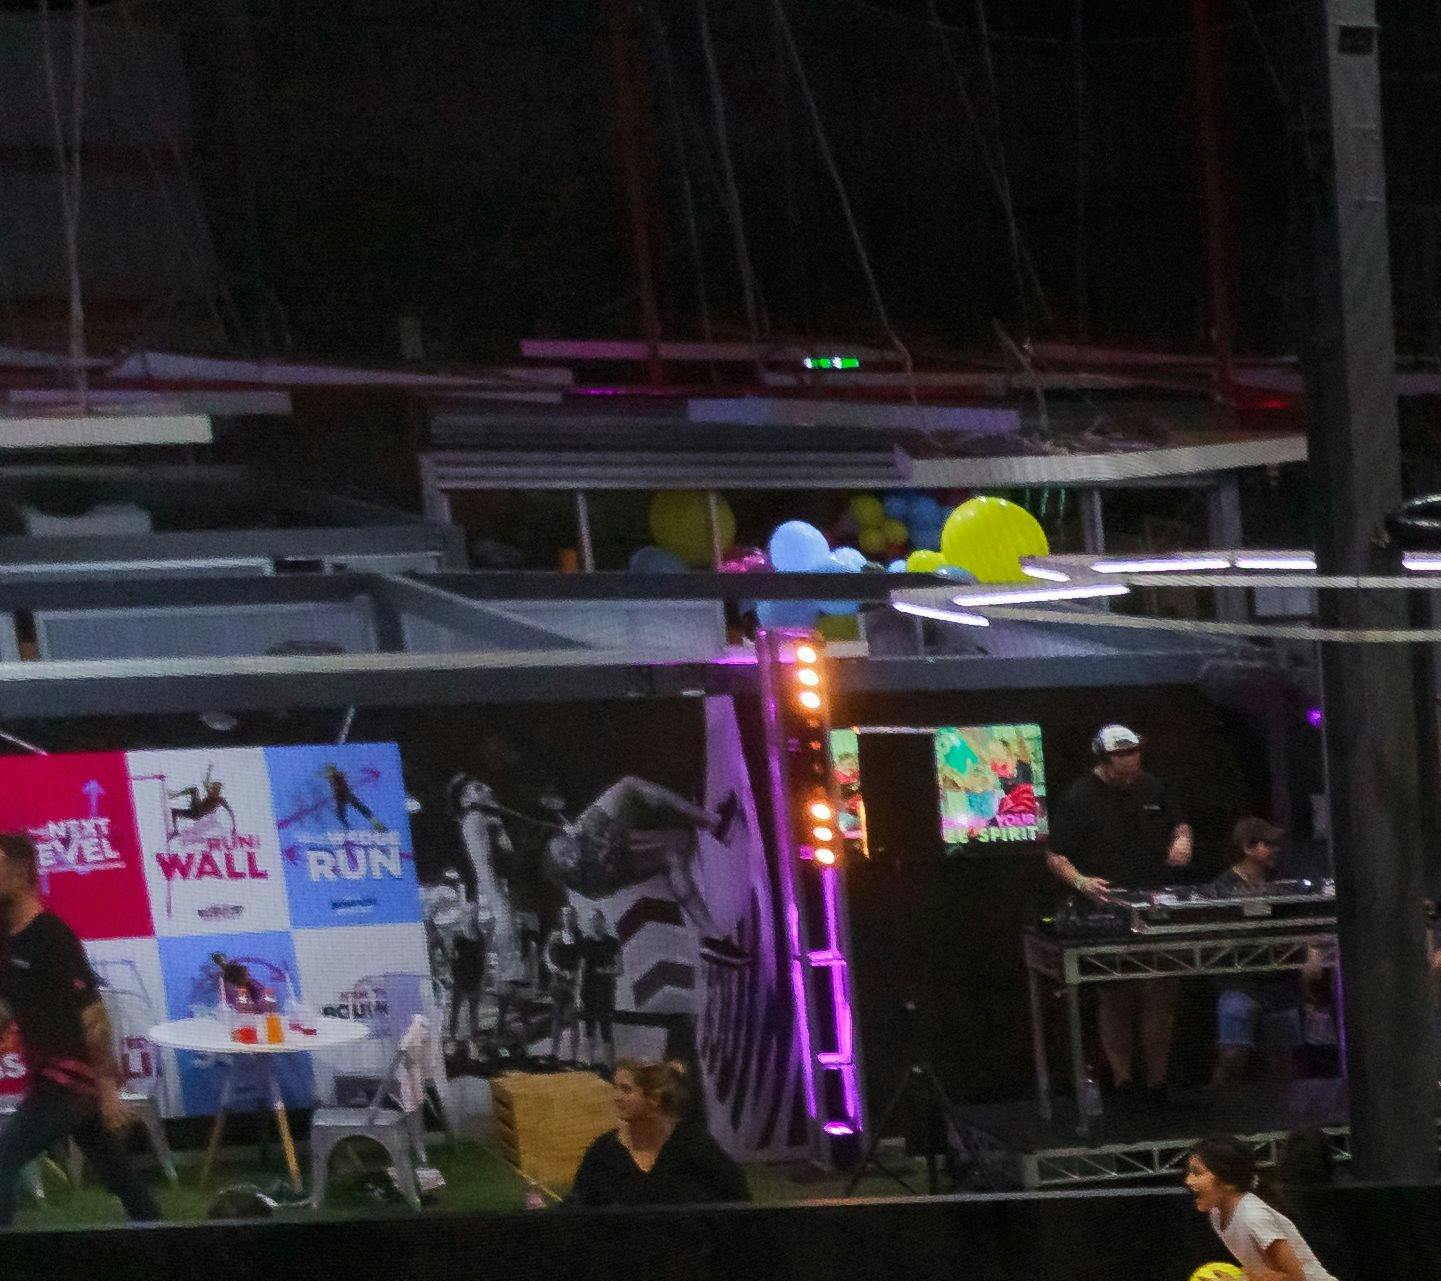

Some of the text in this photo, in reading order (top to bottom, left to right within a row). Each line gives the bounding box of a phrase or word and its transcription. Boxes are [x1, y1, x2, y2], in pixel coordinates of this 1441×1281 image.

[36, 838, 121, 868] EVEL
[155, 851, 270, 881] WALL
[308, 846, 403, 882] RUN
